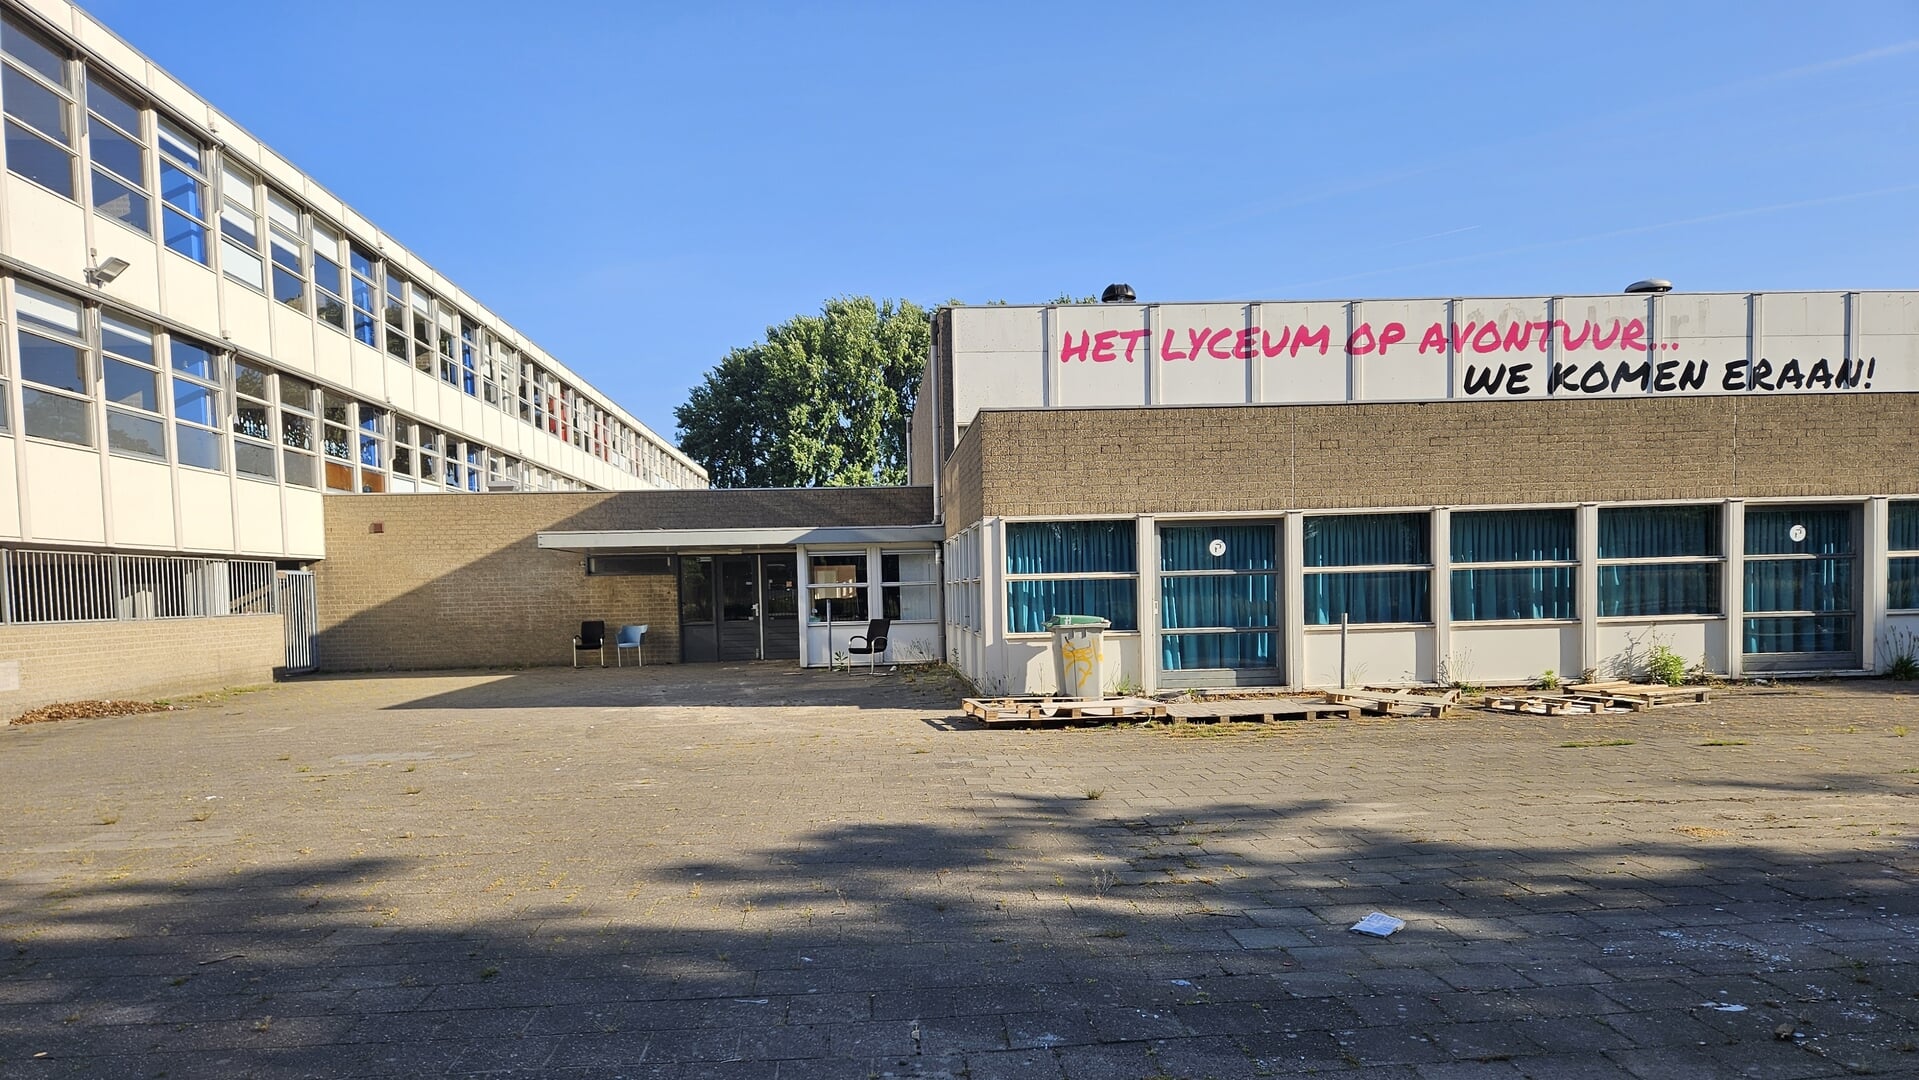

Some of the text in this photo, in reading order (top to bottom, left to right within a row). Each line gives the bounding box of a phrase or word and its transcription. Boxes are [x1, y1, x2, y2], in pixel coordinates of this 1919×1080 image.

[1060, 329, 1151, 362] HET
[1161, 325, 1329, 361] LYCEUM
[1345, 322, 1406, 356] OP
[1418, 319, 1679, 354] AVONTUUR...
[1463, 355, 1876, 395] WE KOMEN ERAAN!
